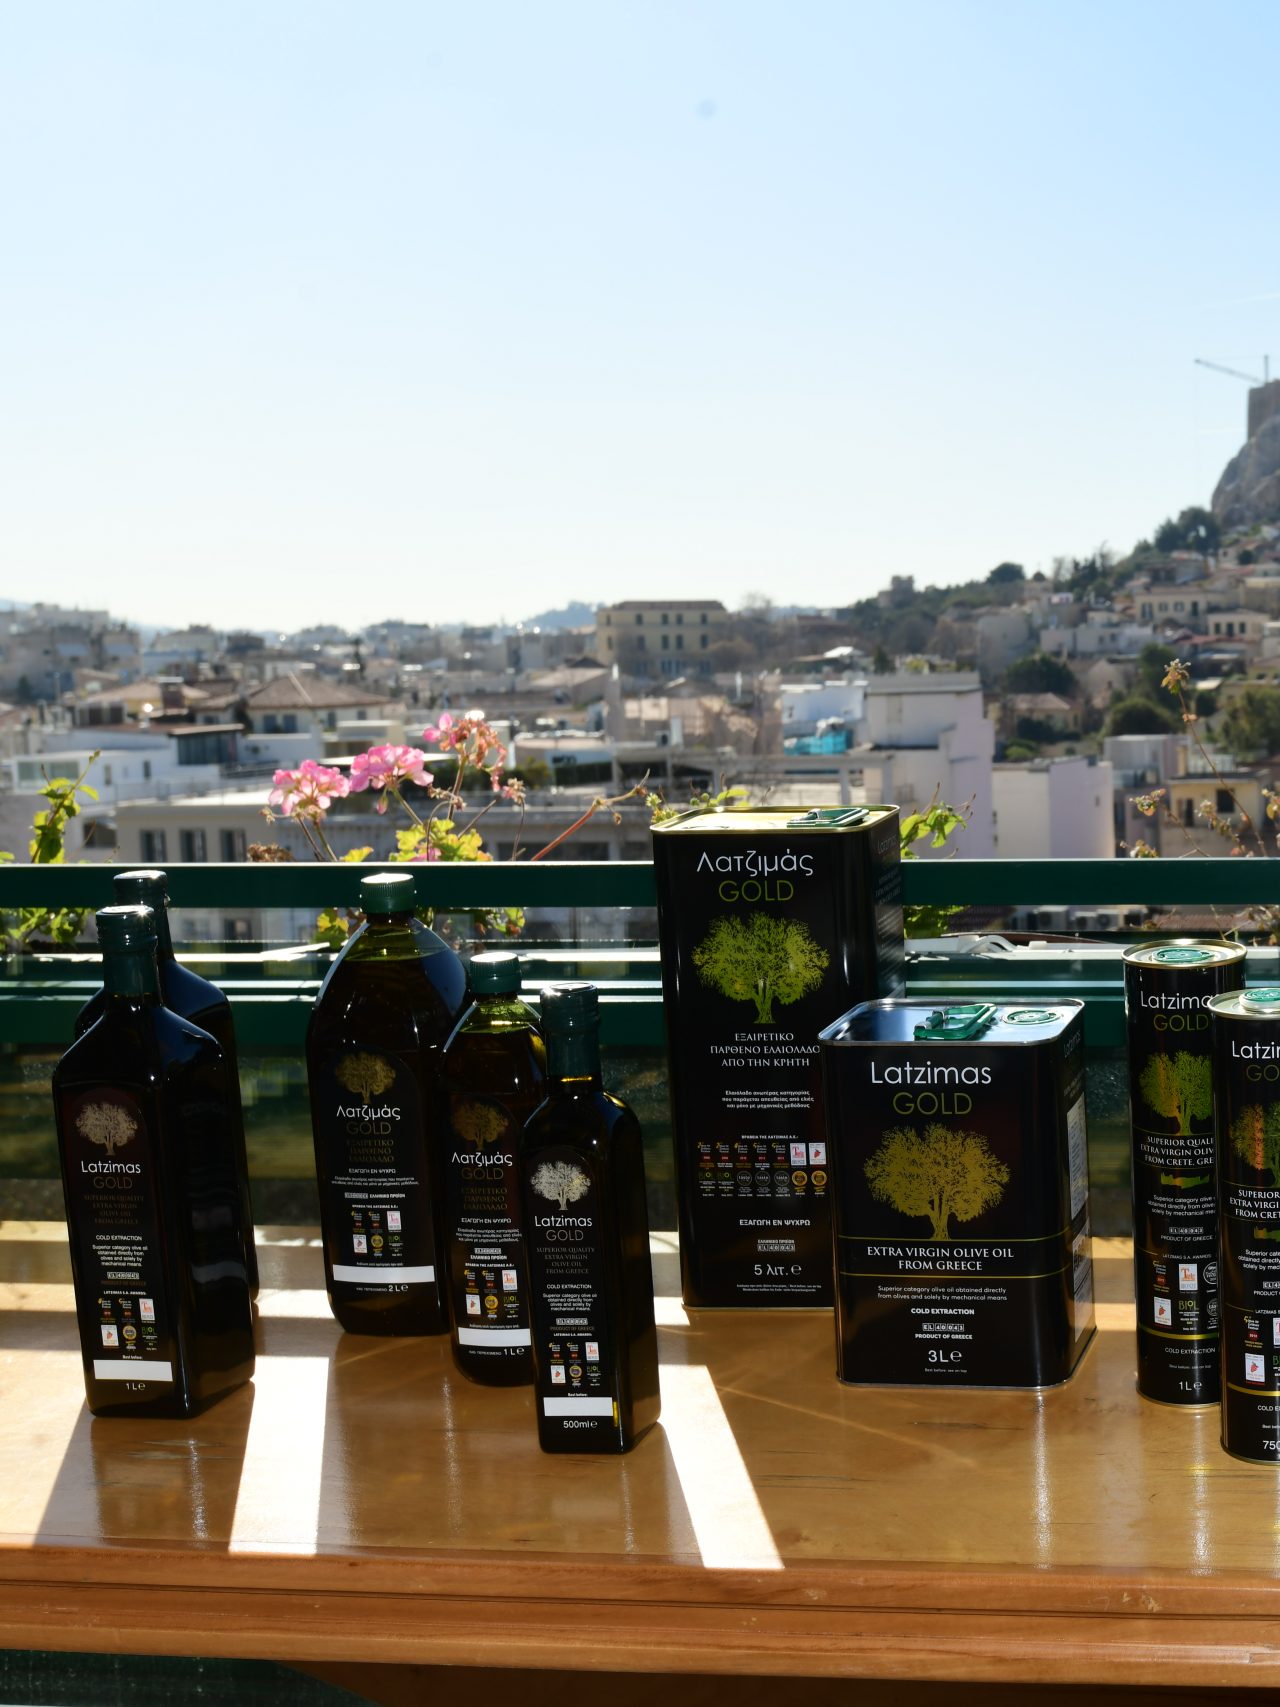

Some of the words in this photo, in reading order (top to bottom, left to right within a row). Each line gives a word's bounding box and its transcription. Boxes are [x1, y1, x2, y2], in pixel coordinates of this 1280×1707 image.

[697, 849, 814, 877] Λατζιμάς
[718, 880, 794, 902] GOLD
[1141, 990, 1214, 1010] Latzima
[1154, 1014, 1209, 1031] GOLD
[735, 1033, 794, 1041] ΕΞΑΙΡΕΤΙΚΟ
[710, 1045, 761, 1054] ΠΑΡΘΕΝΟ
[722, 1058, 745, 1067] ΑΠΟ
[749, 1058, 771, 1067] ΤΗΝ
[774, 1058, 810, 1067] ΚΡΗΤΗ
[871, 1061, 992, 1084] Latzimas
[893, 1092, 973, 1115] GOLD
[336, 1105, 400, 1120] Λατζιμάς
[346, 1122, 391, 1135] GOLD
[1147, 1136, 1185, 1146] SUPERIOR
[1159, 1148, 1192, 1156] VIRGIN
[452, 1152, 513, 1167] Λατζιμάς
[1145, 1155, 1165, 1164] FROM
[81, 1161, 141, 1173] Latzimas
[461, 1168, 504, 1180] GOLD
[94, 1176, 133, 1189] GOLD
[1238, 1189, 1280, 1199] SUPERIOR
[1230, 1197, 1252, 1207] EXTRA
[1235, 1208, 1258, 1218] FROM
[535, 1215, 592, 1227] Latzimas
[546, 1230, 584, 1241] GOLD
[867, 1247, 903, 1257] EXTRA
[906, 1248, 950, 1257] VIRGIN
[954, 1248, 989, 1257] OLIVE
[992, 1248, 1014, 1258] OIL
[754, 1264, 762, 1275] 5
[899, 1260, 933, 1269] FROM
[937, 1261, 982, 1271] GREECE
[563, 1420, 590, 1428] 500ml
